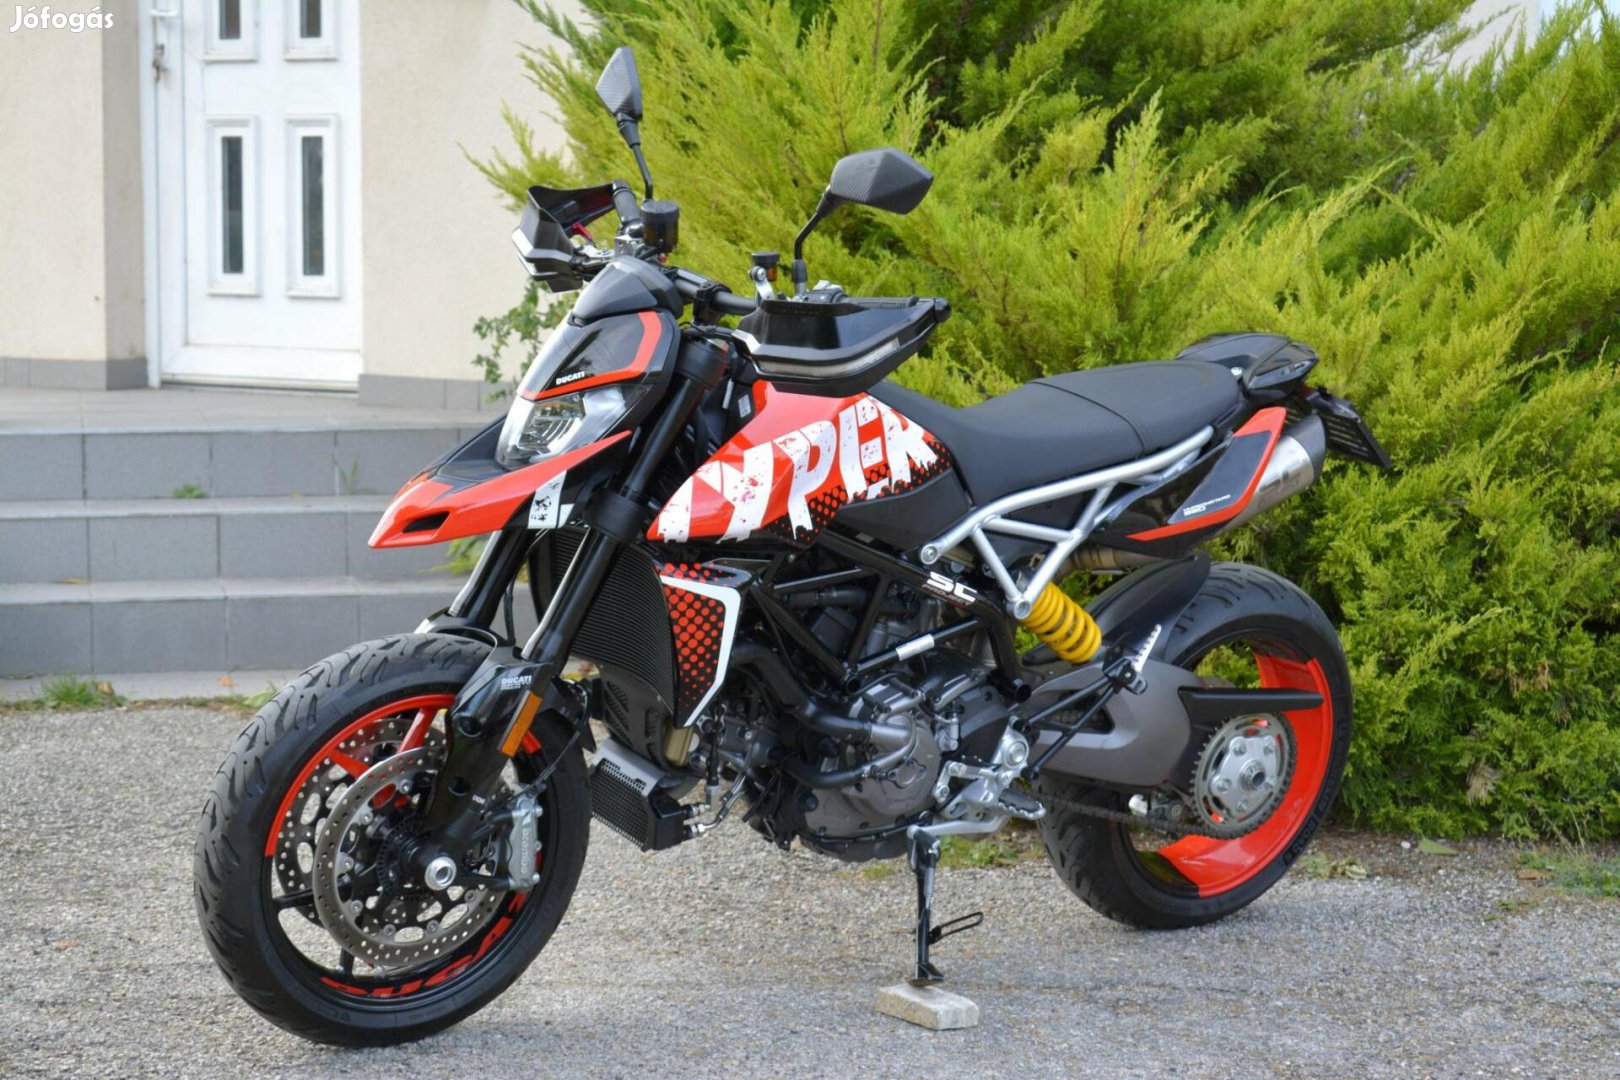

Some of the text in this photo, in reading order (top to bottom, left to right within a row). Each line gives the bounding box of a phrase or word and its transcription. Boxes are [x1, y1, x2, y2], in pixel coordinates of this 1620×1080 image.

[556, 371, 585, 385] DUCATI
[926, 571, 978, 603] SC
[501, 675, 532, 686] DUCATI
